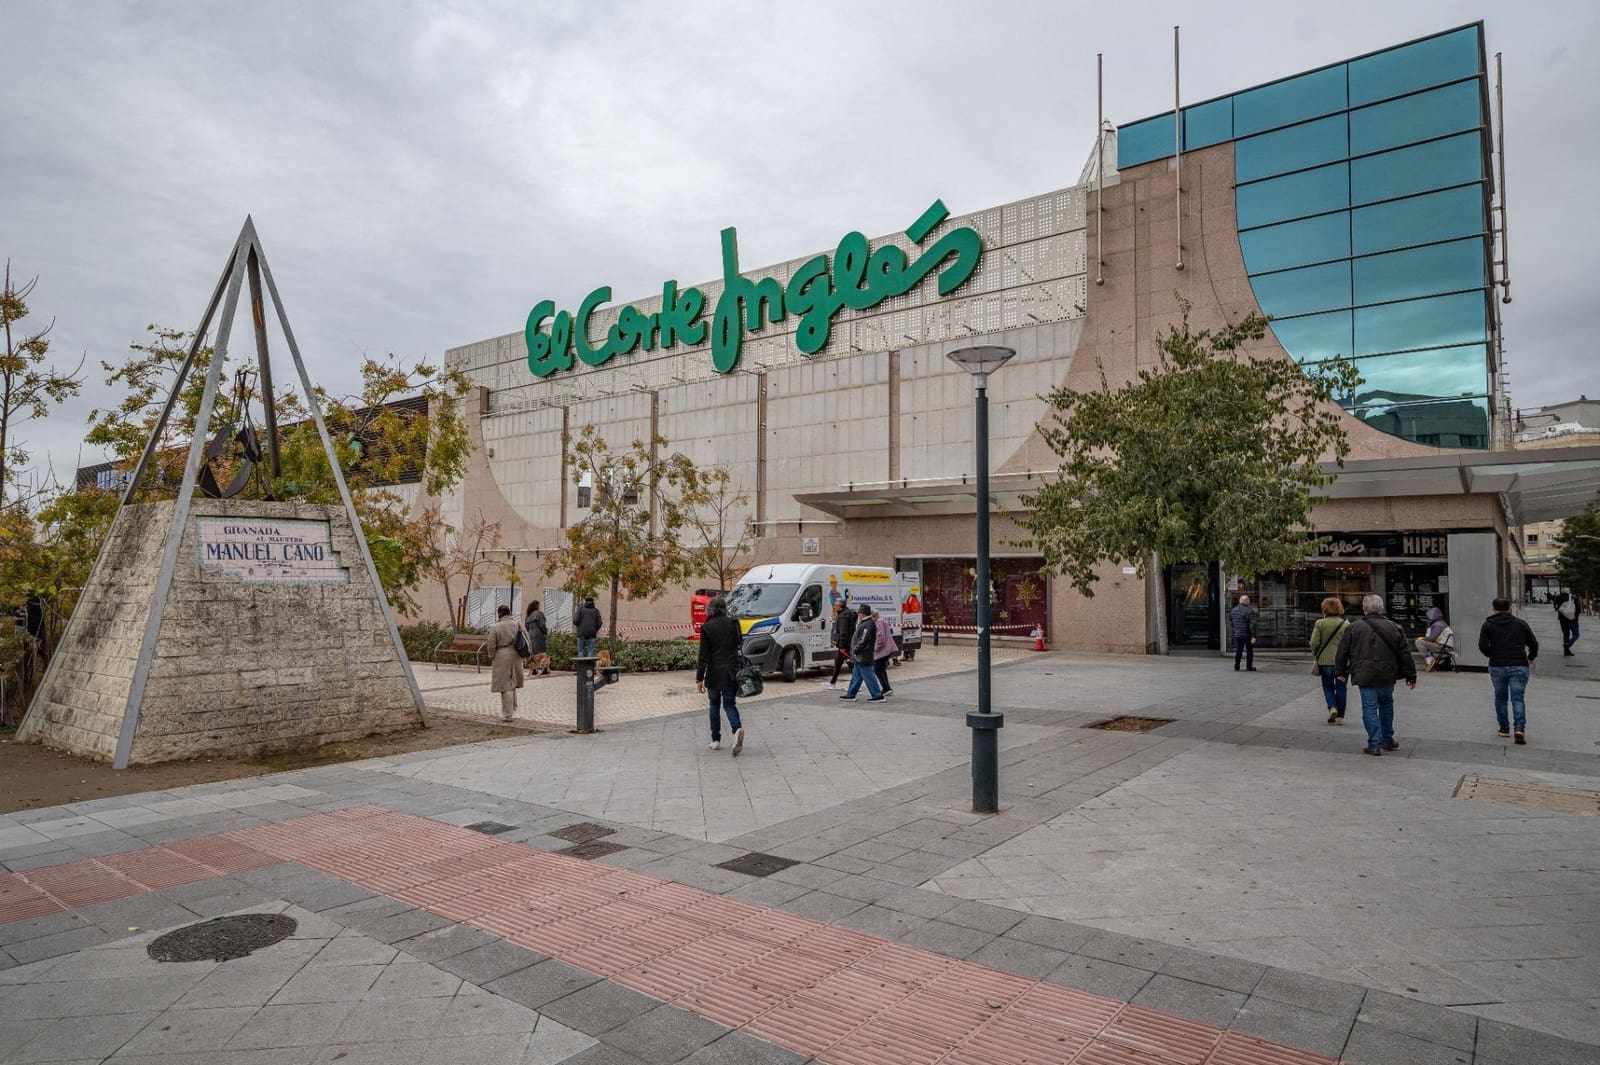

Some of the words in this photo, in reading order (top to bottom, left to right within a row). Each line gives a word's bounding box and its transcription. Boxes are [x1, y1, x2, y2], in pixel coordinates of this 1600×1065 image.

[525, 299, 574, 378] El
[574, 280, 708, 367] Corte
[711, 198, 984, 374] Inglés
[223, 525, 281, 536] GRANADA
[207, 543, 277, 561] MANUEL
[283, 544, 324, 561] CANO
[1402, 535, 1448, 554] HIPER
